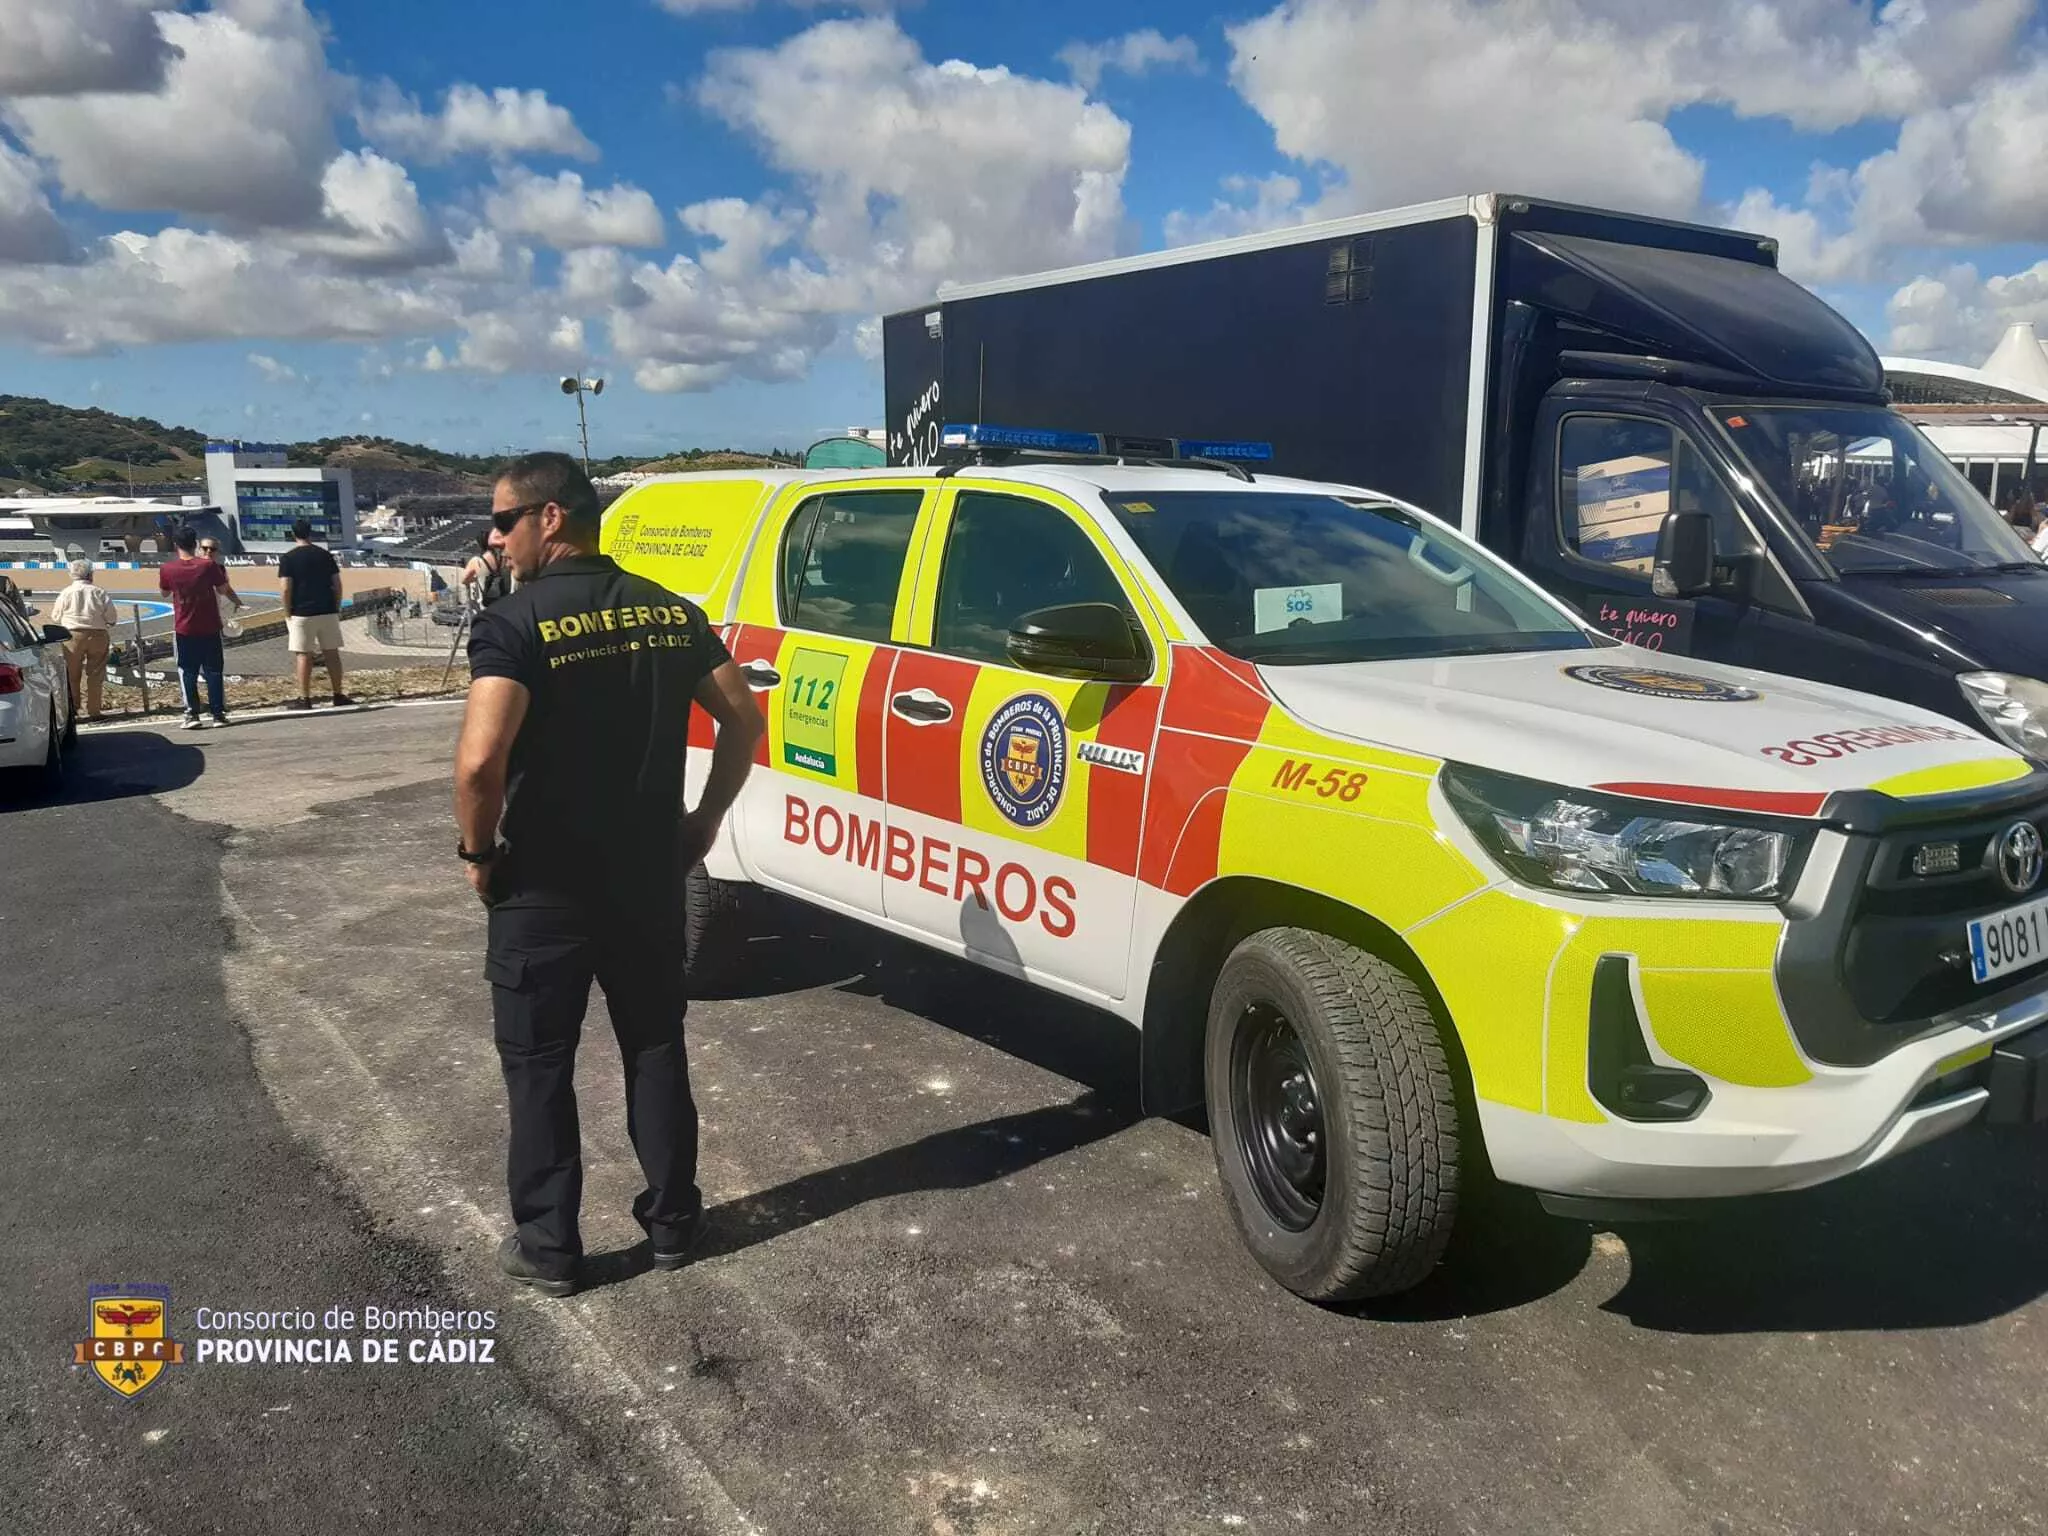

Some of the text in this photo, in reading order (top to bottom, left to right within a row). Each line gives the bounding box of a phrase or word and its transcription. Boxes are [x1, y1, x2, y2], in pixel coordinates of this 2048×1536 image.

[890, 381, 939, 458] te quiero
[640, 525, 712, 538] Consorcio de Bomberos
[634, 542, 671, 555] PROVINCIA
[672, 543, 682, 556] DE
[1286, 600, 1312, 612] SOS
[1600, 603, 1678, 628] te quiero
[537, 605, 688, 643] BOMBEROS
[620, 641, 641, 651] de
[792, 674, 835, 710] 112
[789, 708, 829, 728] Emergencias
[988, 701, 1032, 740] BOMBEROS
[1032, 702, 1043, 715] de
[1042, 707, 1051, 722] la
[984, 743, 993, 757] de
[1048, 716, 1064, 783] PROVINCIA
[1077, 743, 1143, 772] HILUX
[985, 760, 1017, 817] CONSORCIO
[1047, 786, 1058, 801] DE
[1271, 759, 1368, 802] M-58
[784, 794, 1077, 938] BOMBEROS
[1987, 912, 2040, 968] 9081
